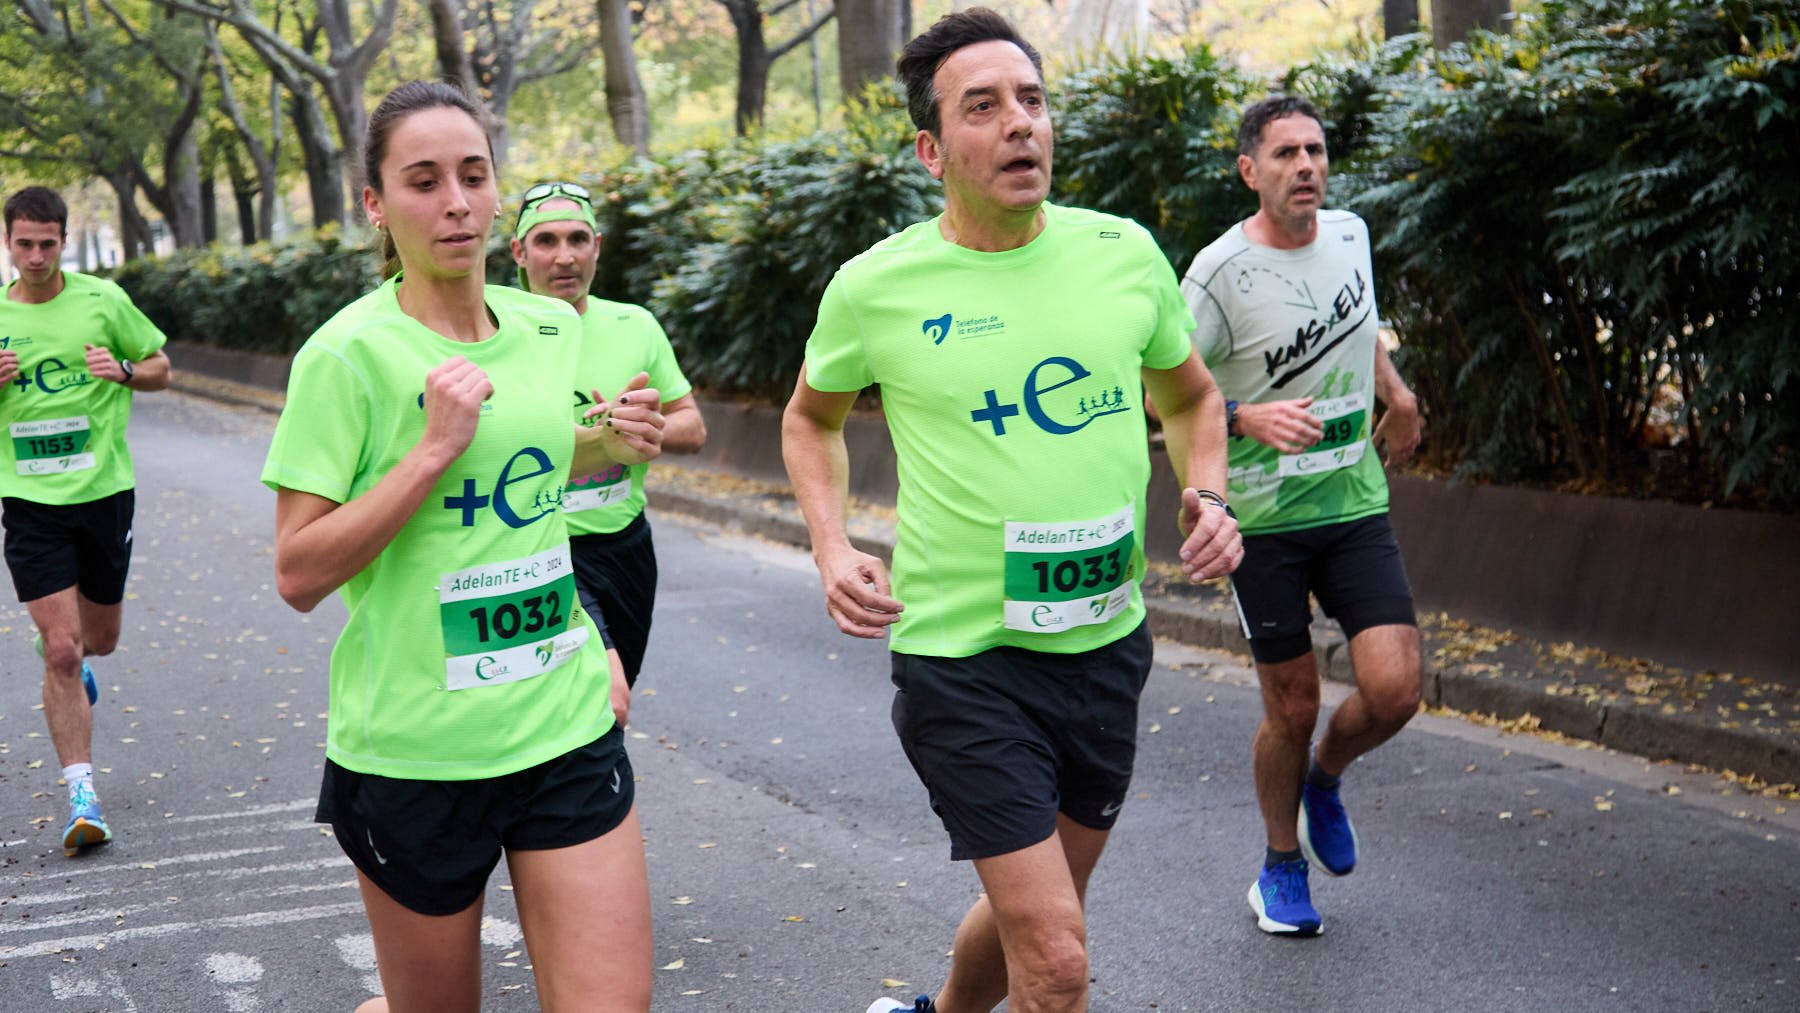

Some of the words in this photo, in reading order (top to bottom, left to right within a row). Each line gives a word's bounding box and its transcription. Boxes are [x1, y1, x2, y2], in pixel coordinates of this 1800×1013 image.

[28, 435, 74, 456] 1153
[1317, 419, 1352, 446] 49
[1016, 529, 1086, 544] AdelanTE
[451, 567, 520, 592] AdelanTE
[547, 557, 562, 572] 2024
[1032, 547, 1120, 593] 1033
[469, 590, 562, 643] 1032
